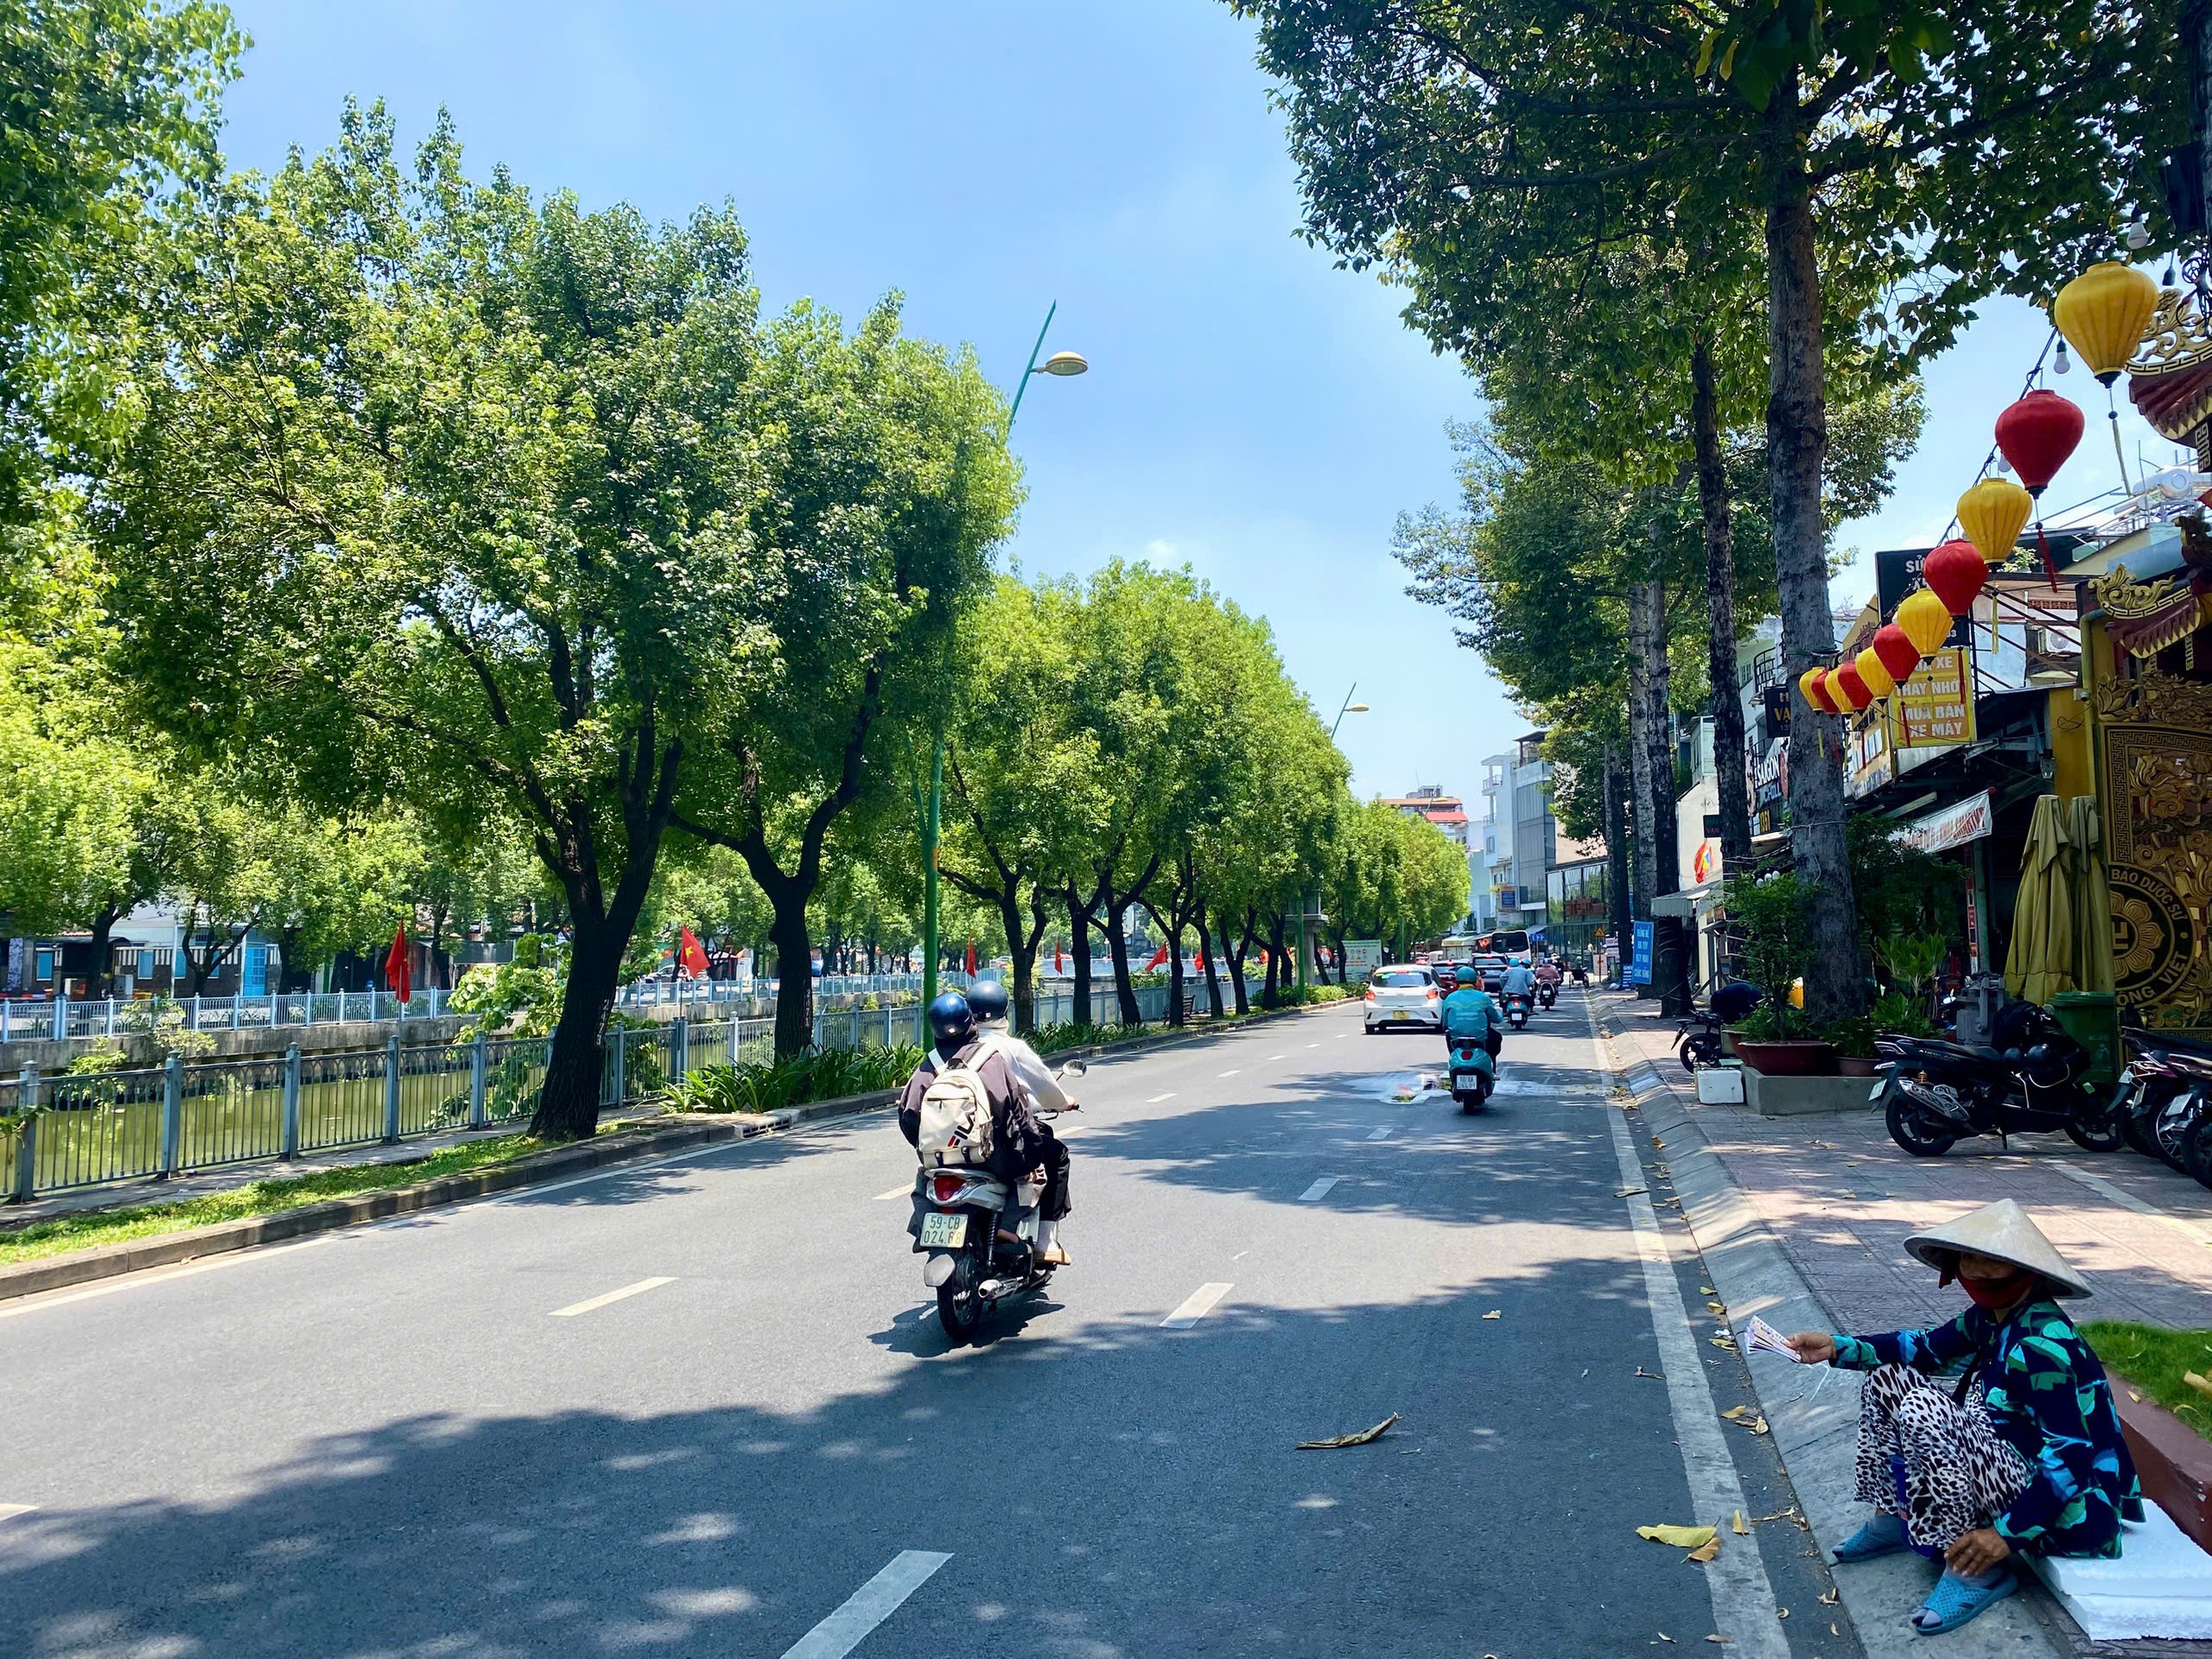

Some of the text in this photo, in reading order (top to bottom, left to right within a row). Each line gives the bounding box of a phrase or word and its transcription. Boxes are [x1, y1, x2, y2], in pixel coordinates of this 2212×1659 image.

[1905, 555, 1924, 573] SỬ
[1936, 656, 1954, 670] XE
[1896, 678, 1967, 696] THAY NHỚ
[1902, 702, 1966, 721] MUA BÁN
[1910, 720, 1962, 738] XE MÁY
[1758, 754, 1781, 787] SAIGON
[2168, 903, 2189, 921] SƯ
[930, 1216, 961, 1230] 59-CB
